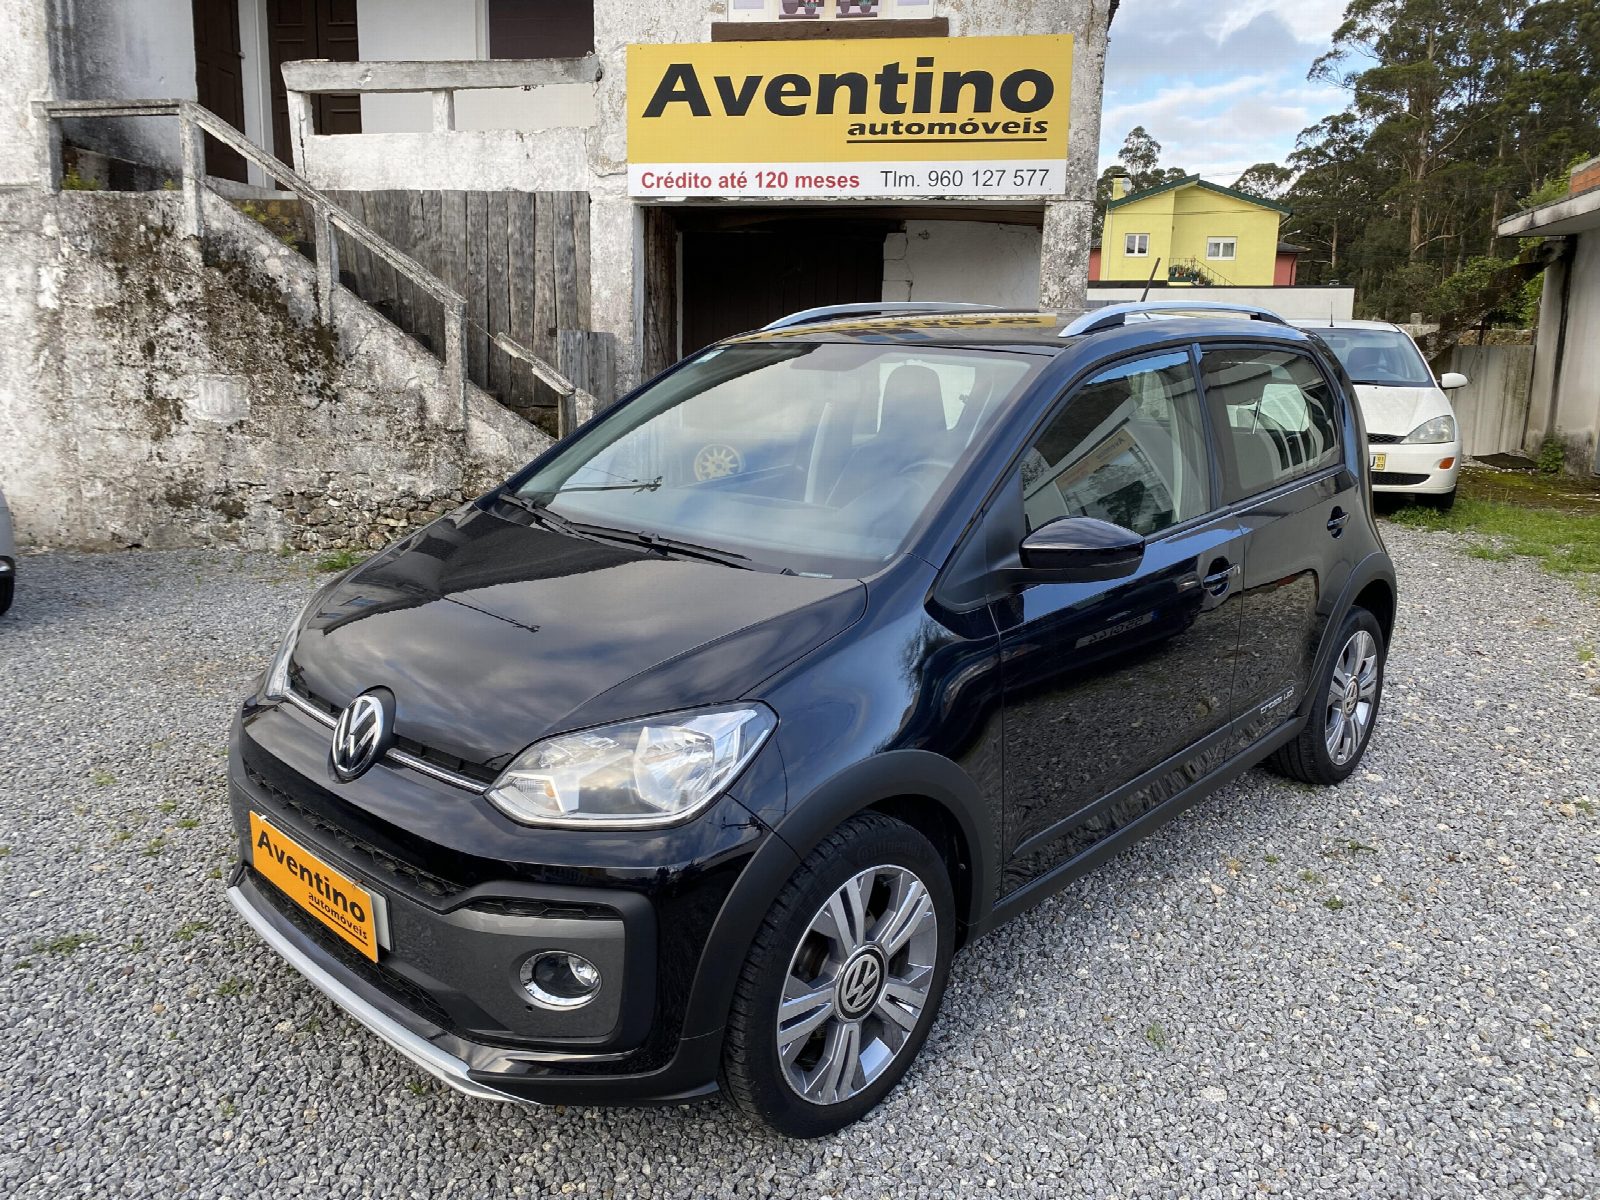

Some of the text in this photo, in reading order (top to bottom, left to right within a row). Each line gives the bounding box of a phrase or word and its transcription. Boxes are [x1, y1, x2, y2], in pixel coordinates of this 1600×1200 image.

[641, 56, 1055, 118] Aventino
[847, 117, 1048, 136] automóveis
[640, 168, 1050, 189] Crédito até 120 meses Tlm. 960 127 577
[257, 829, 367, 923] Aventino
[308, 892, 368, 940] automóveis
